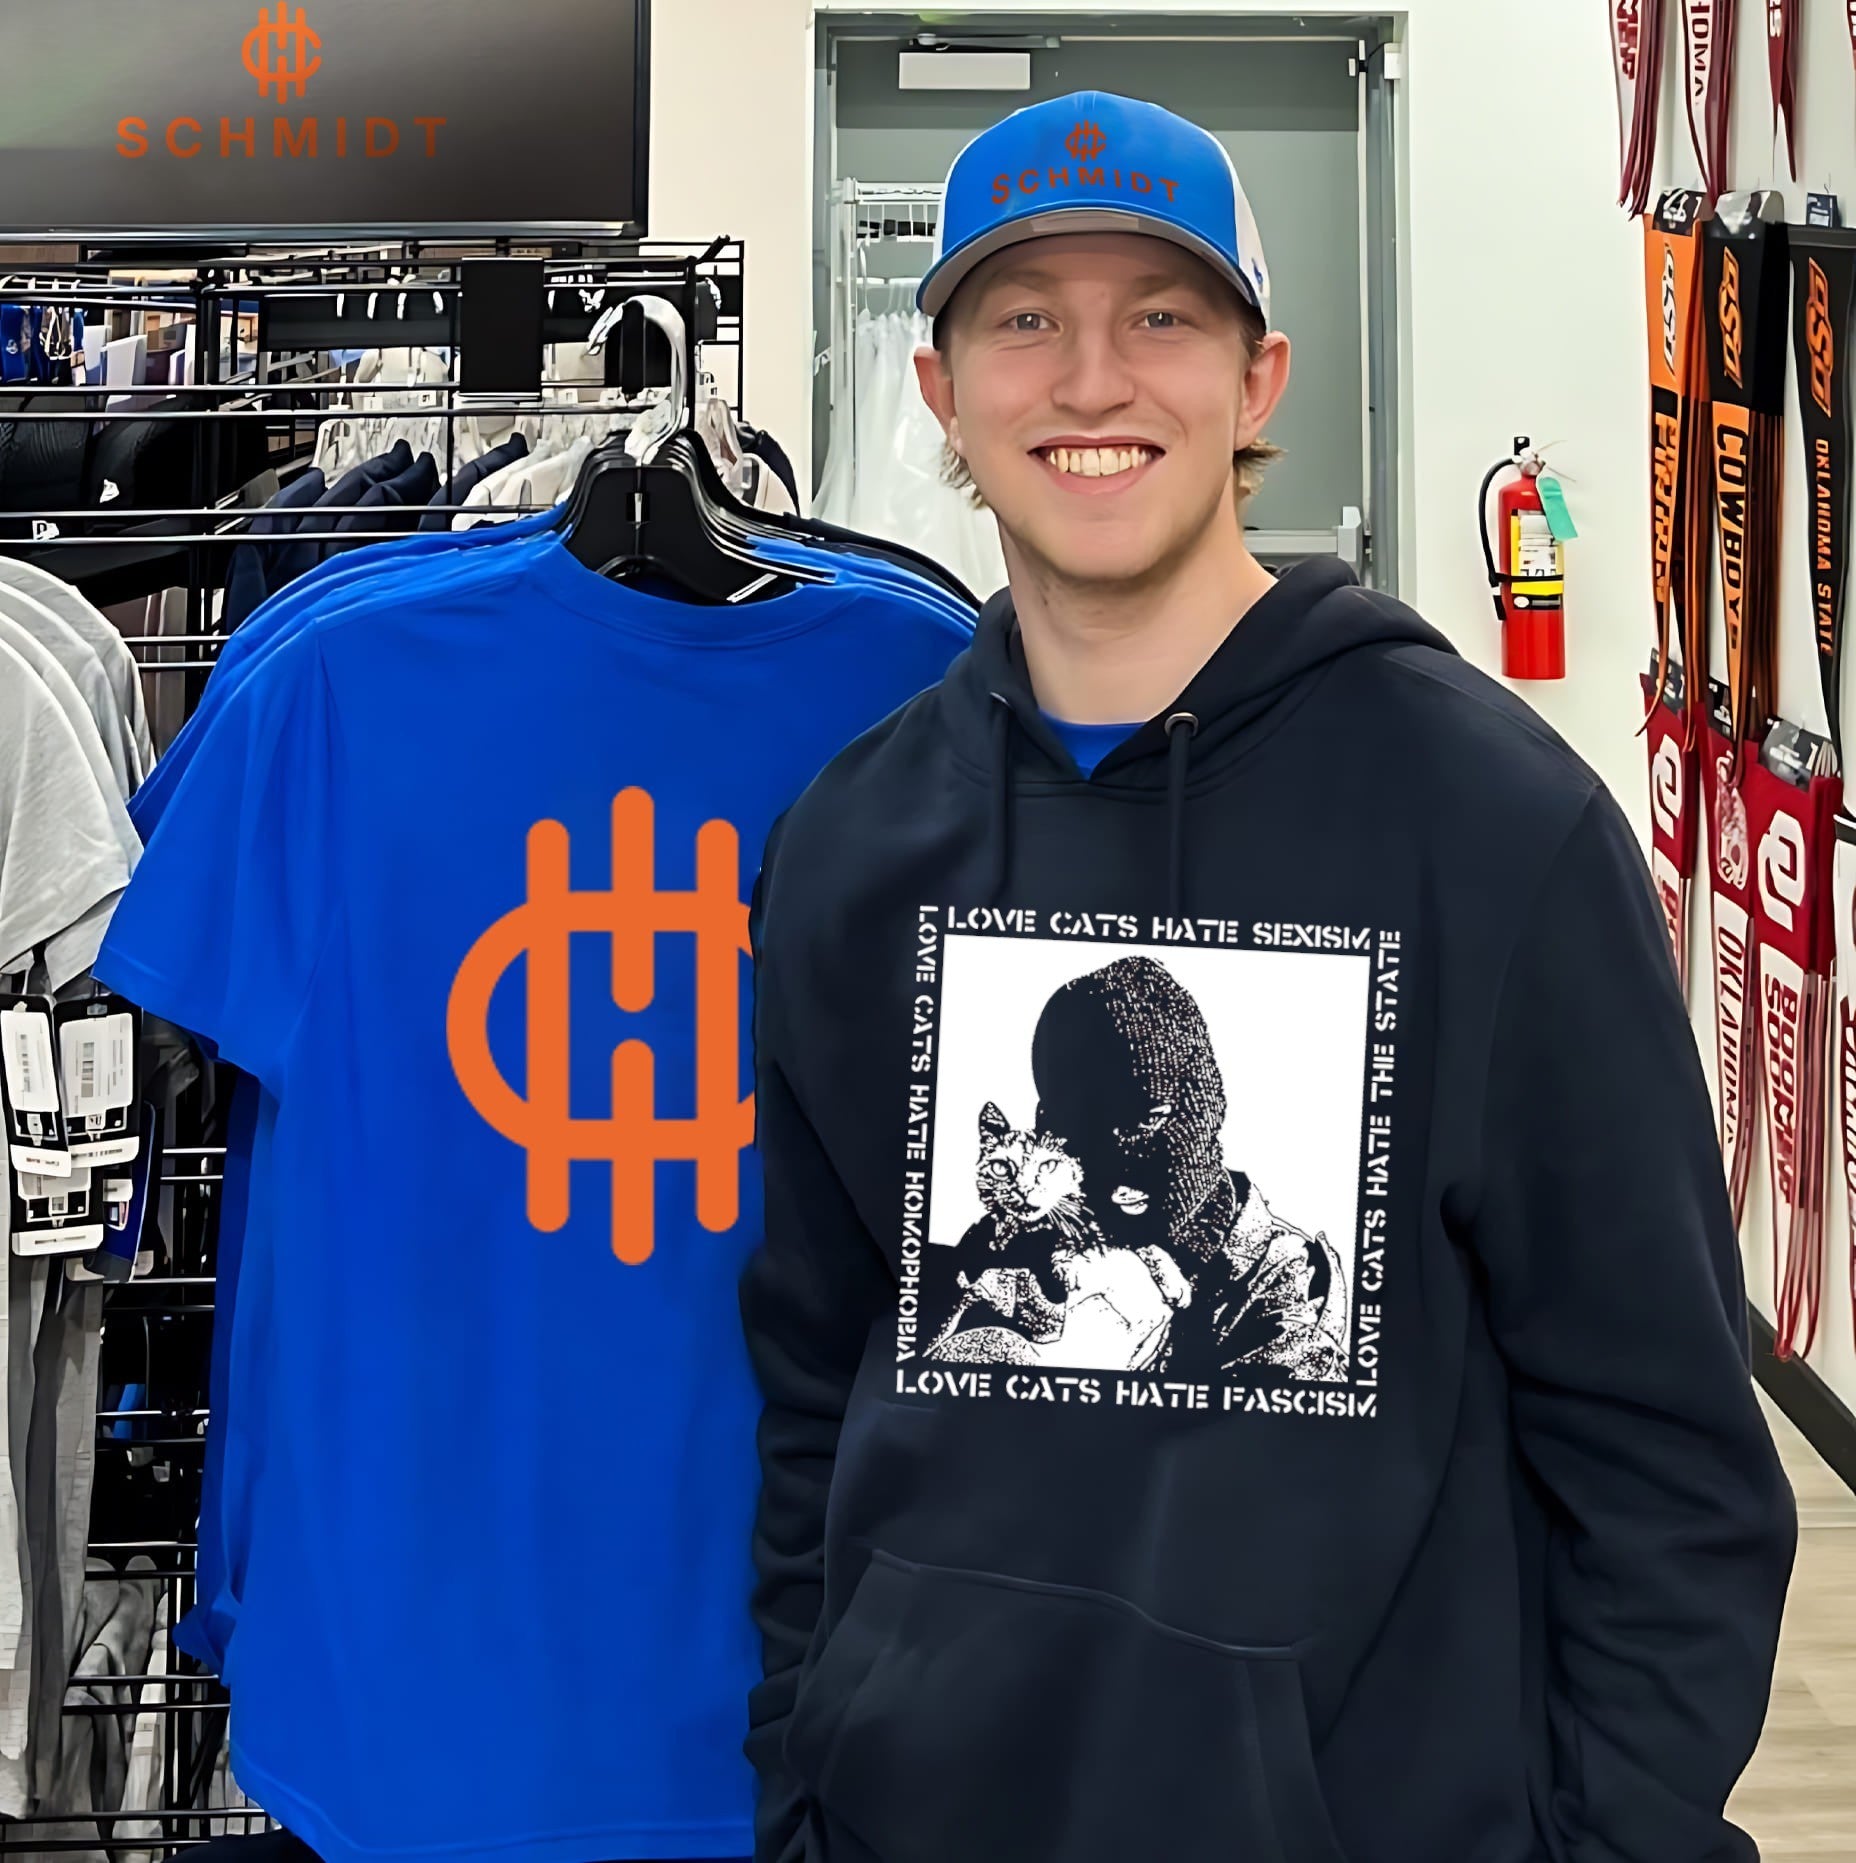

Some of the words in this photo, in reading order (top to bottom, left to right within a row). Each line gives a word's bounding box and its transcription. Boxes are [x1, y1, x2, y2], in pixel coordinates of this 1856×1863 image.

[116, 117, 447, 158] SCHMIDT
[992, 166, 1179, 204] SCHMIDT
[1815, 438, 1832, 570] OKLAHOMA
[916, 905, 938, 984] LOVE
[948, 905, 1036, 932] LOVE
[1050, 911, 1138, 938] CATS
[1152, 917, 1238, 943] HATE
[1253, 921, 1371, 950] SEXISM
[1375, 930, 1400, 1032] STATE
[911, 994, 933, 1073] CATS
[1371, 1043, 1394, 1102] THE
[1719, 925, 1745, 1144] OKLAHOMA
[907, 1084, 929, 1161] HATE
[1366, 1115, 1390, 1196] HATE
[896, 1171, 925, 1363] HOMOPHOBIA
[1362, 1208, 1386, 1292] CATS
[1357, 1304, 1381, 1386] LOVE
[896, 1368, 992, 1397] LOVE
[1006, 1375, 1101, 1403] CATS
[1115, 1380, 1209, 1409] HATE
[1223, 1386, 1377, 1418] FASCISM
